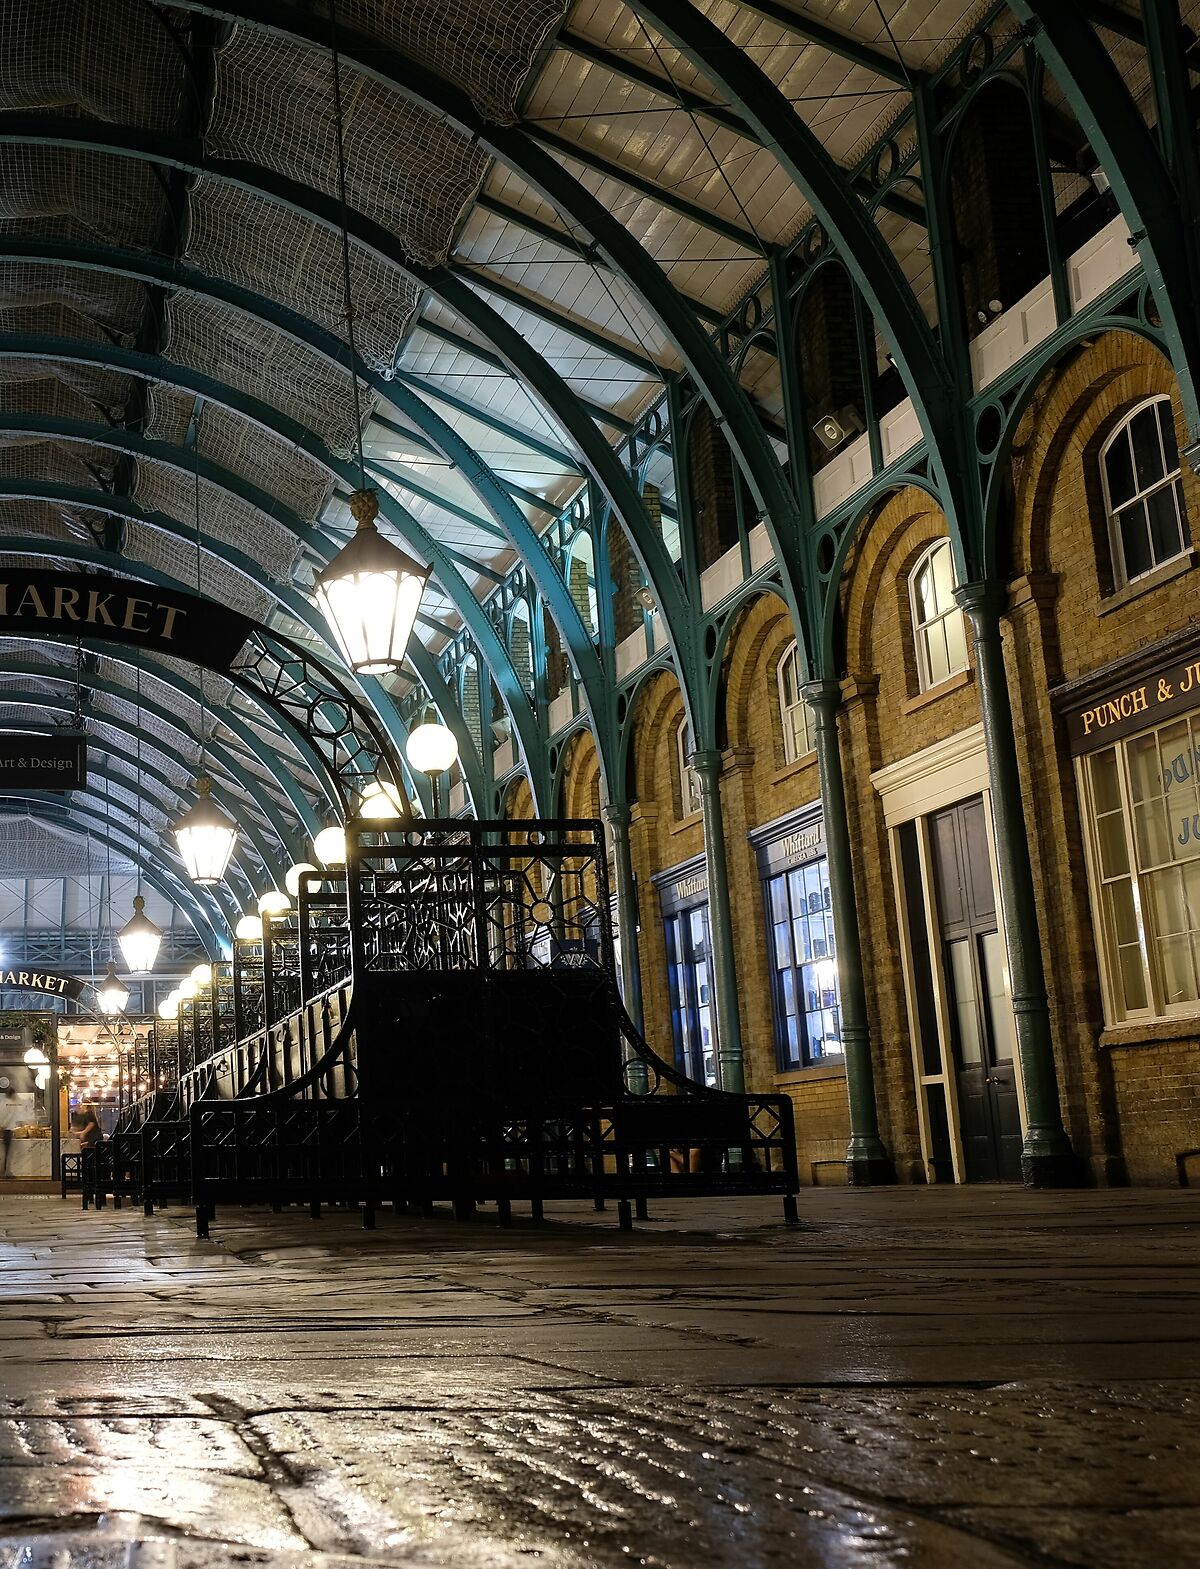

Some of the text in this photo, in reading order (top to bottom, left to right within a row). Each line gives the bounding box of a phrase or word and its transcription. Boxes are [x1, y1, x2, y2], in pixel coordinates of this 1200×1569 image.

[1081, 687, 1149, 735] PUNCH
[1157, 678, 1174, 702] &
[18, 758, 27, 768] &
[30, 757, 73, 771] Design
[781, 823, 821, 857] Whittard
